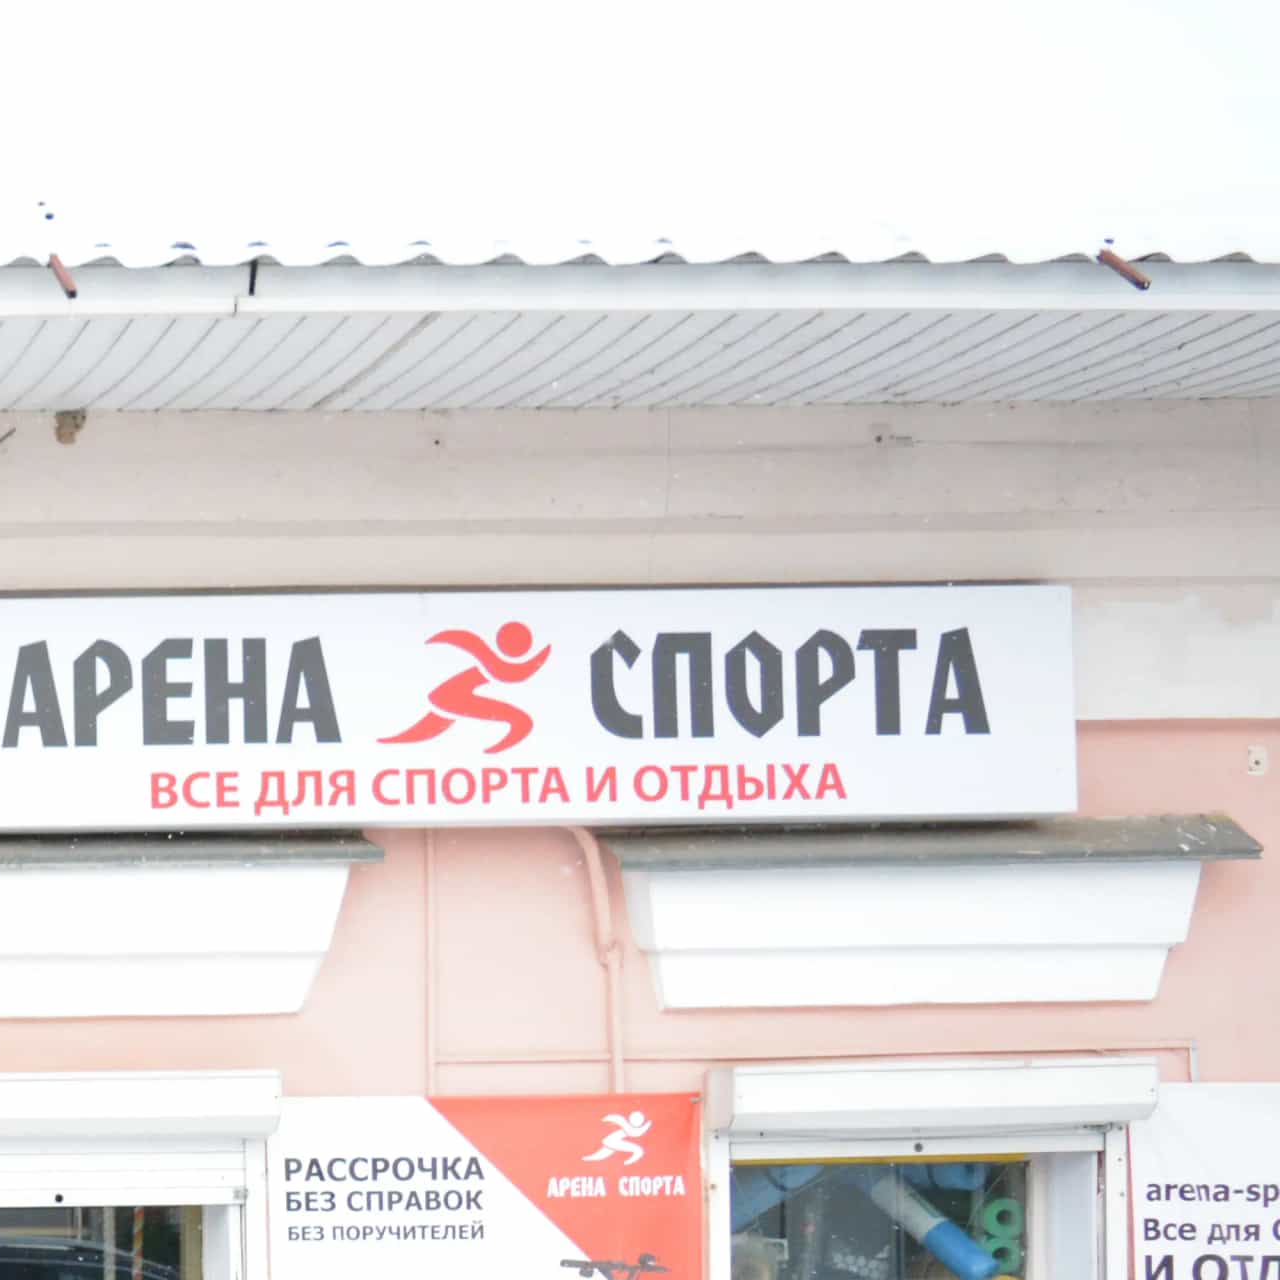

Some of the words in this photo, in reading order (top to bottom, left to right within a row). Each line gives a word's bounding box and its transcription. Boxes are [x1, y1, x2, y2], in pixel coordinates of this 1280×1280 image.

[2, 636, 342, 748] АРЕНА
[590, 627, 991, 739] СПОРТА
[151, 770, 240, 809] ВСЕ
[254, 769, 355, 816] ДЛЯ
[371, 766, 571, 806] СПОРТА
[586, 767, 617, 802] И
[633, 762, 847, 810] ОТДЫХА
[284, 1156, 485, 1182] РАССРОЧКА
[547, 1176, 606, 1198] АРЕНА
[618, 1175, 685, 1197] СПОРТА
[1146, 1183, 1280, 1208] arena-sp
[286, 1190, 336, 1212] БЕЗ
[347, 1189, 483, 1212] СПРАВОК
[288, 1225, 324, 1241] БЕЗ
[332, 1221, 485, 1241] ПОРУЧИТЕЛЕЙ
[1144, 1218, 1197, 1241] Все
[1208, 1223, 1260, 1245] для
